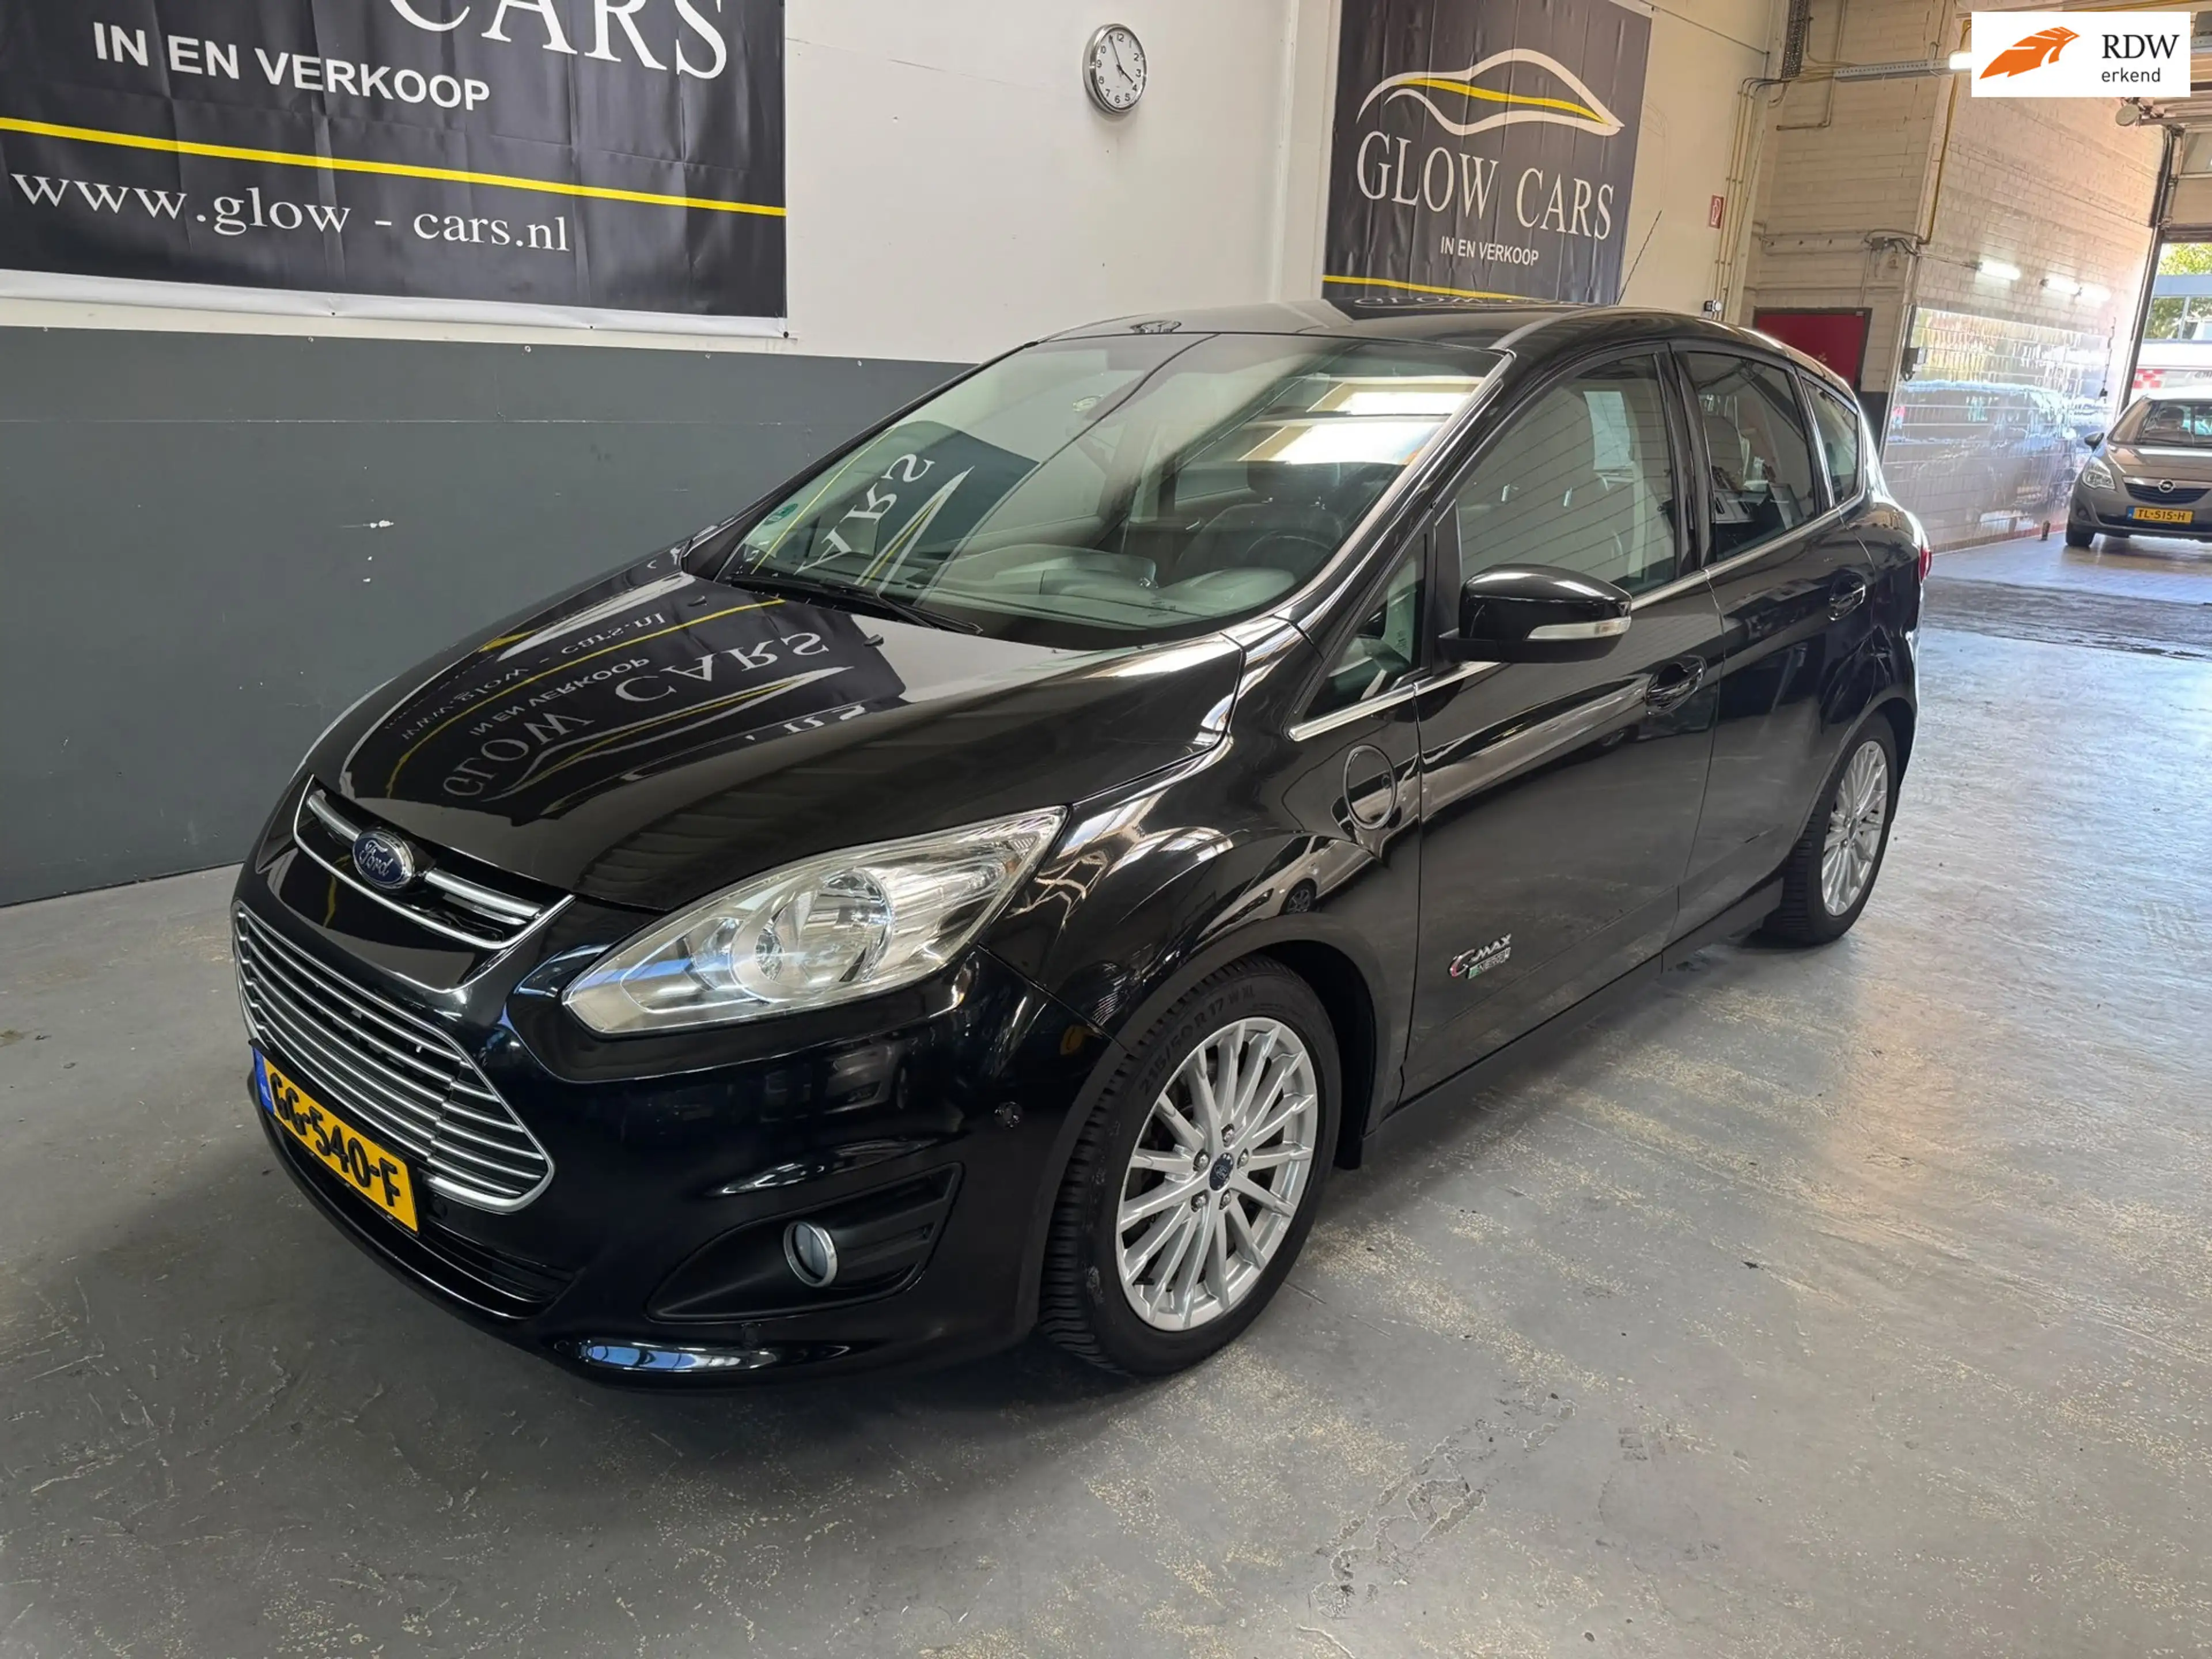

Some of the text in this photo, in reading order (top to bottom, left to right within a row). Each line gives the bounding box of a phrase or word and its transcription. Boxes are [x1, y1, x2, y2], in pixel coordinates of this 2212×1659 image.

[93, 22, 490, 110] IN EN VERKOOP
[1357, 131, 1615, 240] GLOW CARS
[412, 211, 571, 252] cars.nl
[1440, 236, 1539, 266] IN EN VERKOOP
[2138, 509, 2186, 520] TL-515-H
[359, 839, 394, 877] Ford
[270, 1072, 401, 1207] GG-540-F
